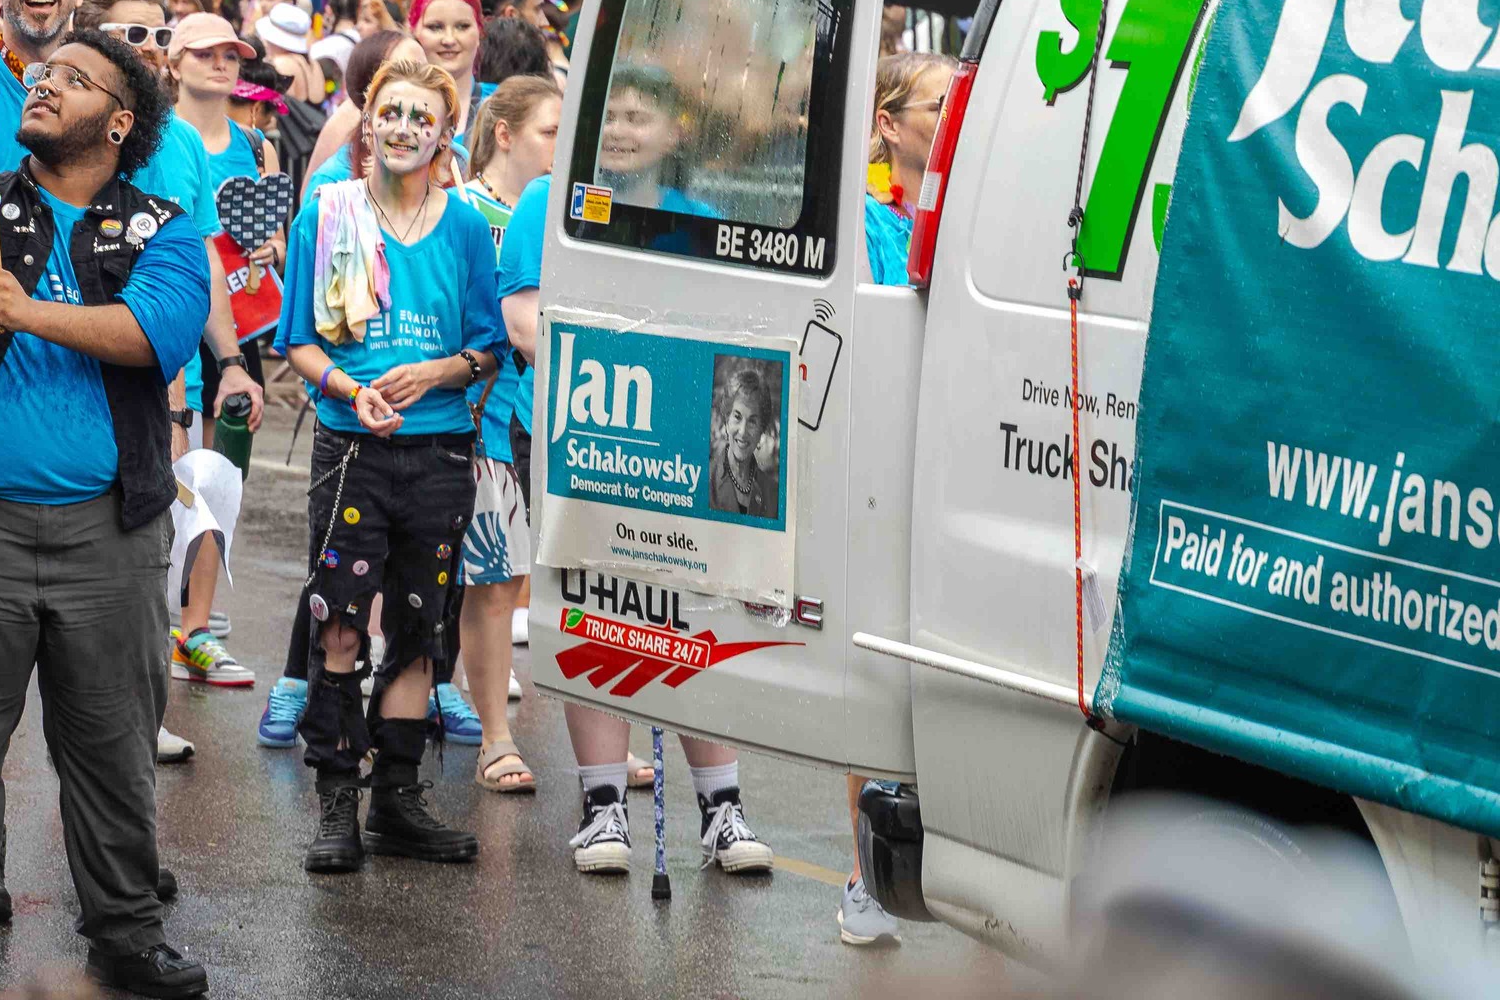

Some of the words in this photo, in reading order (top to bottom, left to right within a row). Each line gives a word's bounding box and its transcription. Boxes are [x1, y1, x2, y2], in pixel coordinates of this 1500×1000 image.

[716, 224, 745, 259] BE
[748, 229, 799, 267] 3480
[803, 235, 826, 270] M
[369, 340, 390, 351] UNTIL
[551, 331, 653, 444] Jan
[1022, 378, 1060, 407] Drive
[1106, 393, 1140, 420] Ren
[566, 437, 702, 494] Schakowsky
[1000, 422, 1077, 481] Truck
[570, 474, 622, 497] Democrat
[624, 482, 640, 500] for
[642, 485, 693, 509] Congress
[1267, 440, 1500, 550] www.jans
[610, 545, 708, 574] www.janschakowsky.org
[616, 522, 636, 542] On
[640, 530, 663, 546] our
[666, 531, 699, 552] side.
[1163, 515, 1227, 577] Paid
[1227, 533, 1269, 588] for
[1267, 553, 1325, 605] and
[1329, 569, 1500, 652] authorized
[585, 617, 626, 646] TRUCK
[627, 627, 671, 657] SHARE
[672, 641, 706, 665] 24/7
